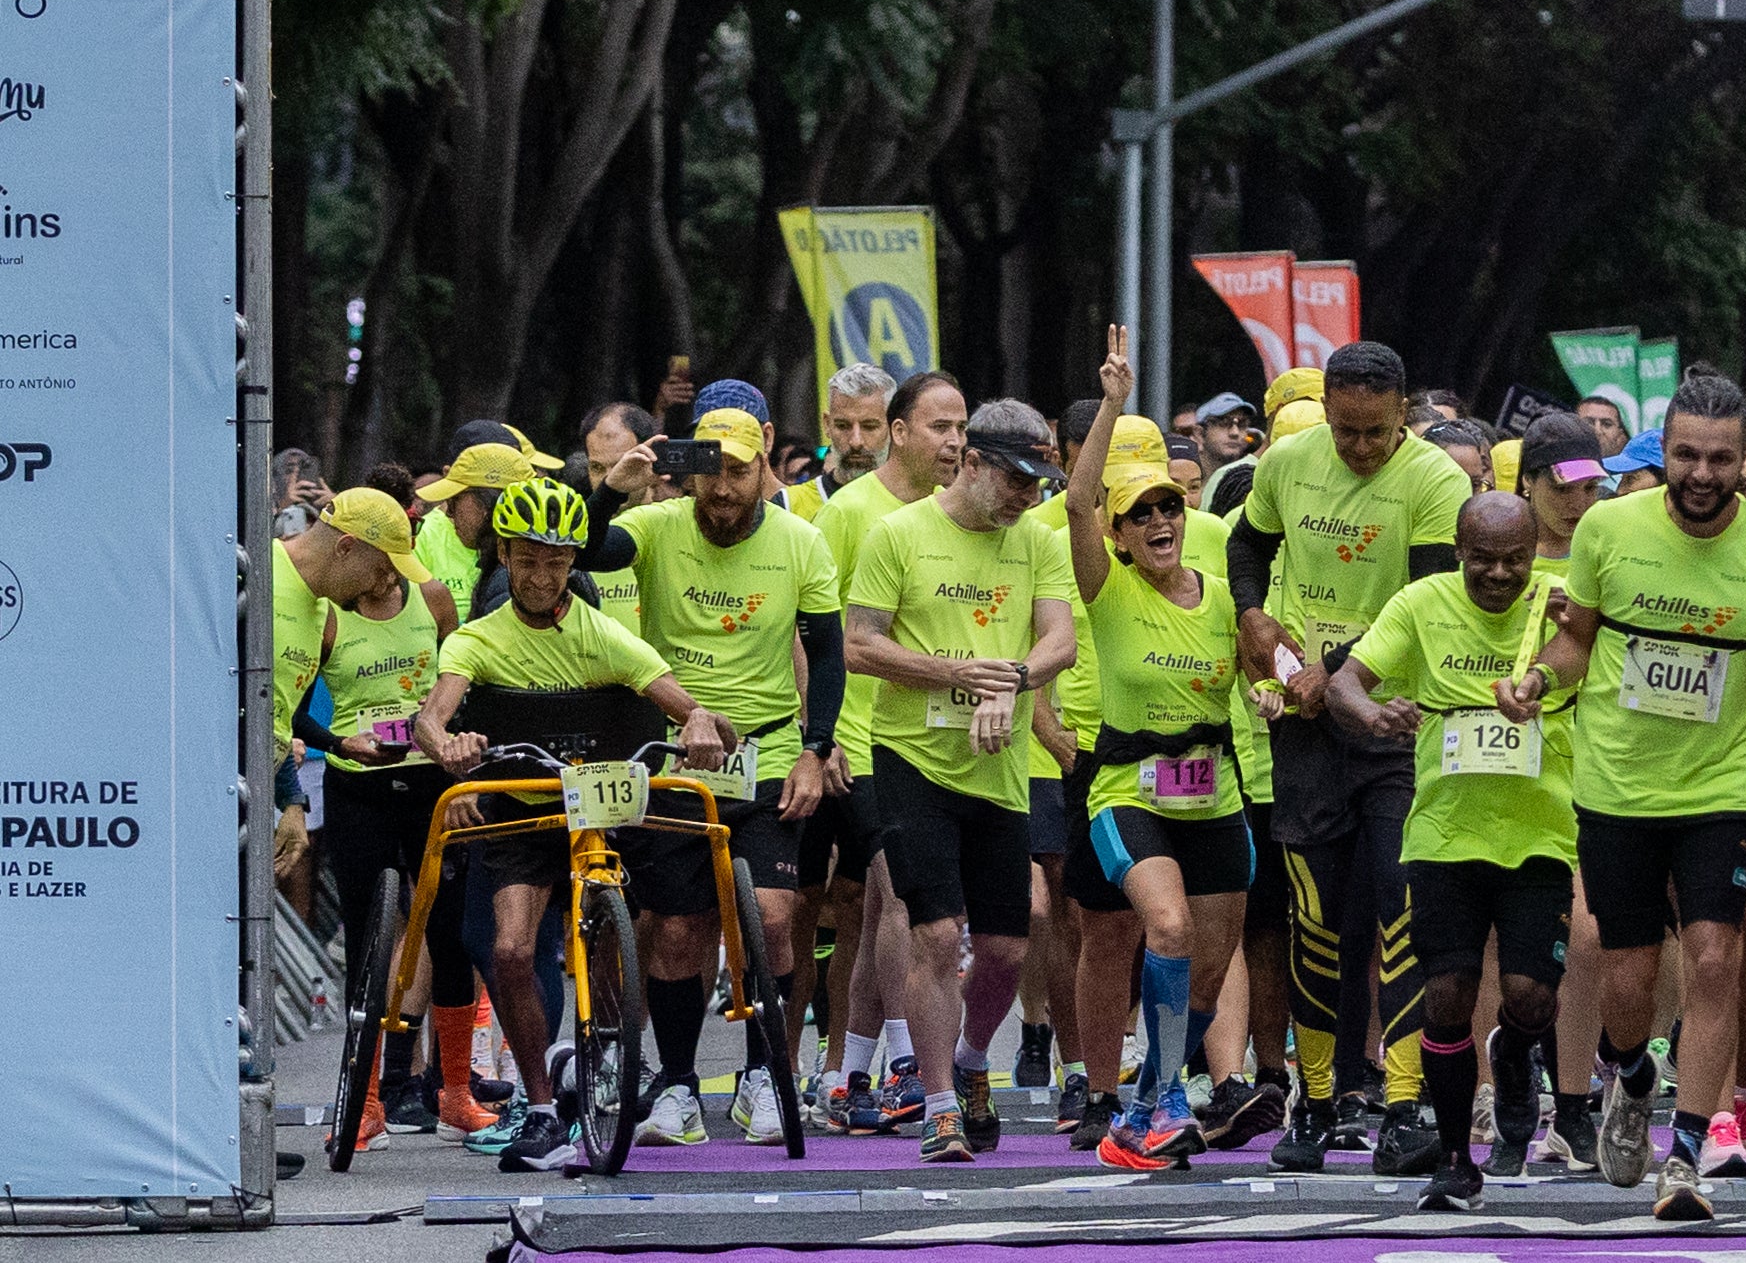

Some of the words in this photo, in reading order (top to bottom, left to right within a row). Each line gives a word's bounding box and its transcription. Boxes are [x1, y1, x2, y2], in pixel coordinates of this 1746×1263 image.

[4, 204, 62, 239] ins
[18, 376, 77, 390] ANTÔNIO
[1298, 514, 1361, 538] Achilles
[682, 586, 744, 609] Achilles
[935, 582, 993, 602] Achilles
[1632, 592, 1711, 619] Achilles
[356, 655, 415, 680] Achilles
[674, 646, 715, 669] GUIA
[1143, 651, 1212, 672] Achilles
[1440, 654, 1515, 672] Achilles
[1647, 661, 1709, 696] GUIA
[1474, 724, 1521, 750] 126
[1170, 760, 1210, 786] 112
[99, 781, 139, 805] DE
[593, 780, 633, 805] 113
[1, 816, 141, 849] PAULO
[28, 861, 54, 877] DE
[9, 882, 19, 898] E
[26, 882, 88, 898] LAZER
